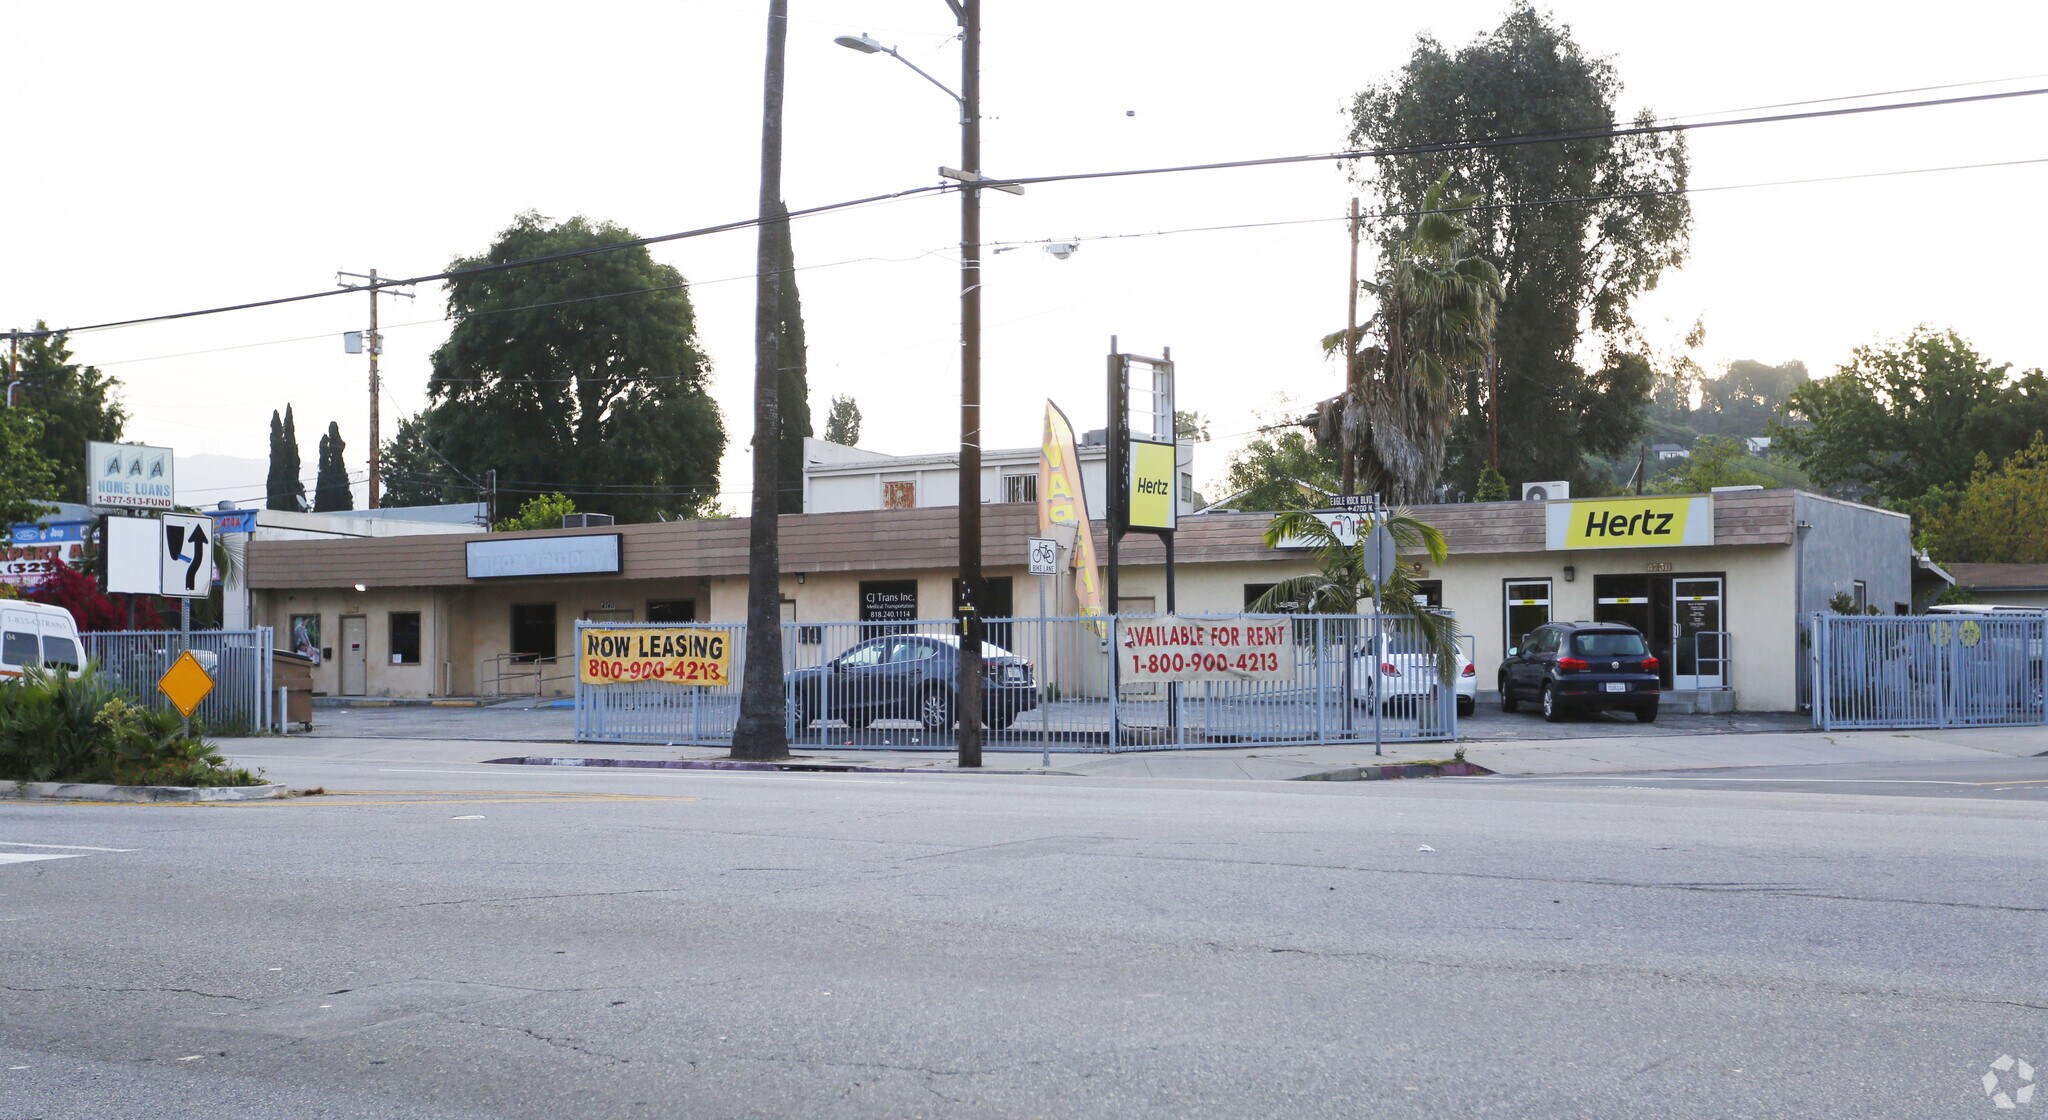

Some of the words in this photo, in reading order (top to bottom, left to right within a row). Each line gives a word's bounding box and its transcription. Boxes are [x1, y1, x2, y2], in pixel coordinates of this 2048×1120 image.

[98, 480, 130, 494] HOME
[135, 483, 170, 497] LOANS
[1137, 477, 1168, 495] Hertz
[98, 495, 171, 507] 1-877-513-FUND
[1330, 496, 1345, 506] EAGLE
[1346, 496, 1359, 505] ROCK
[1360, 495, 1374, 504] BLVD.
[1585, 509, 1674, 537] Hertz
[866, 592, 875, 603] CJ
[877, 592, 899, 602] Trans
[900, 592, 915, 602] Inc.
[870, 610, 911, 618] 818.240.1114
[1125, 626, 1204, 648] AVAILABLE
[1211, 627, 1240, 647] FOR
[1247, 626, 1284, 646] RENT
[588, 635, 630, 658] NOW
[639, 635, 723, 660] LEASING
[589, 659, 721, 680] 800-900-4213
[1132, 652, 1278, 674] 1-800-900-4213
